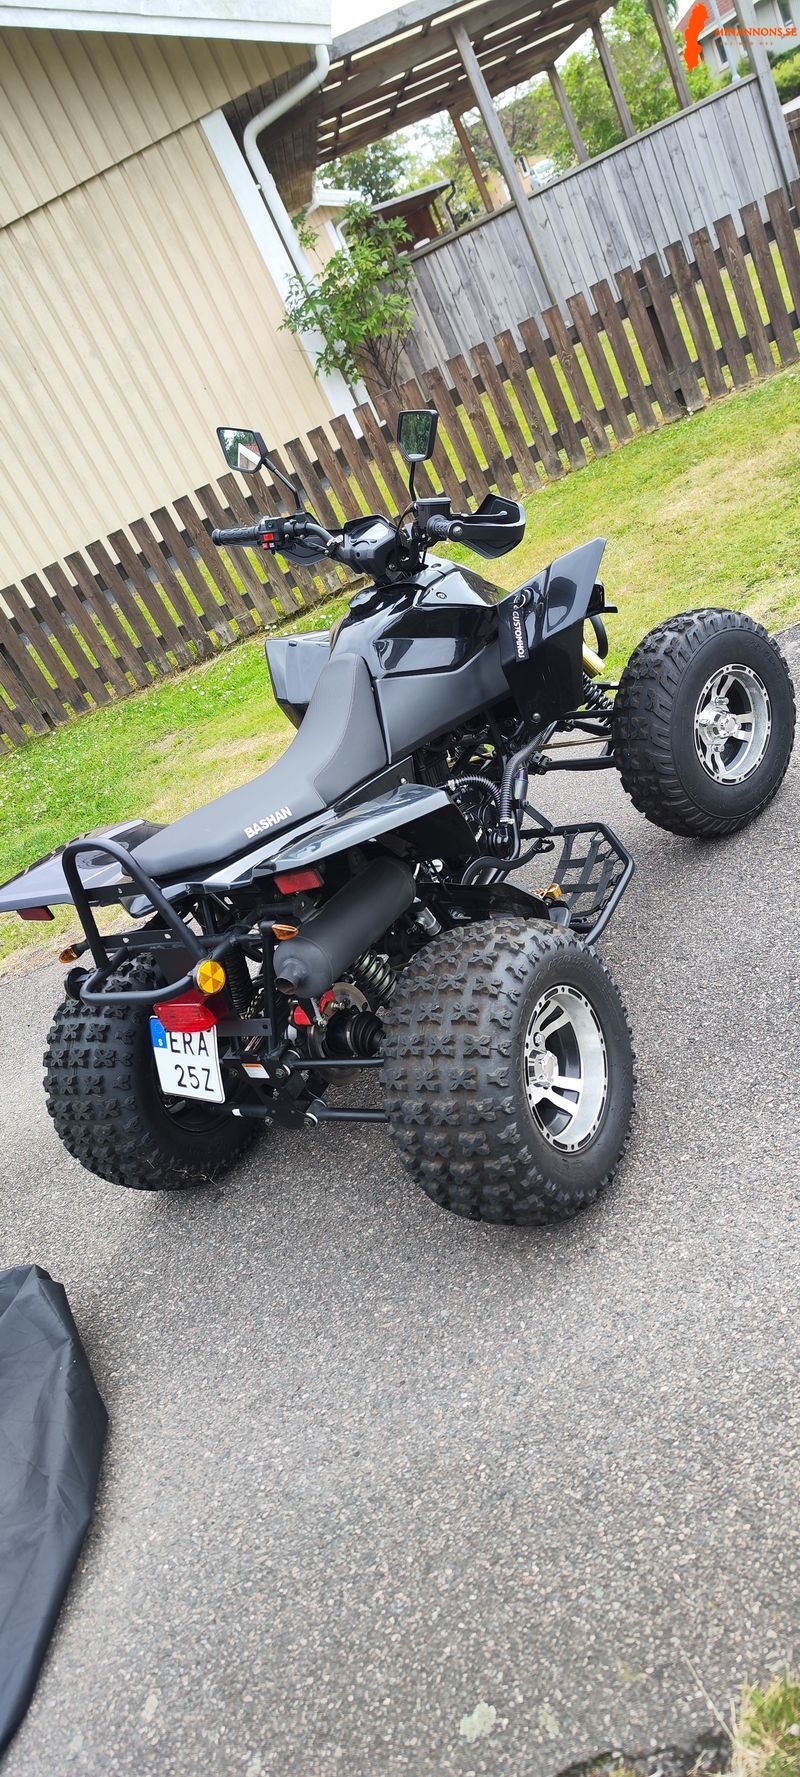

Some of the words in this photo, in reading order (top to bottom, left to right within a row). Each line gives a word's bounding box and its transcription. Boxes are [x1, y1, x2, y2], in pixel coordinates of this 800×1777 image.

[243, 806, 293, 839] BASHAN
[157, 1038, 163, 1046] S
[169, 1031, 209, 1057] ERA
[174, 1064, 215, 1092] 25Z
